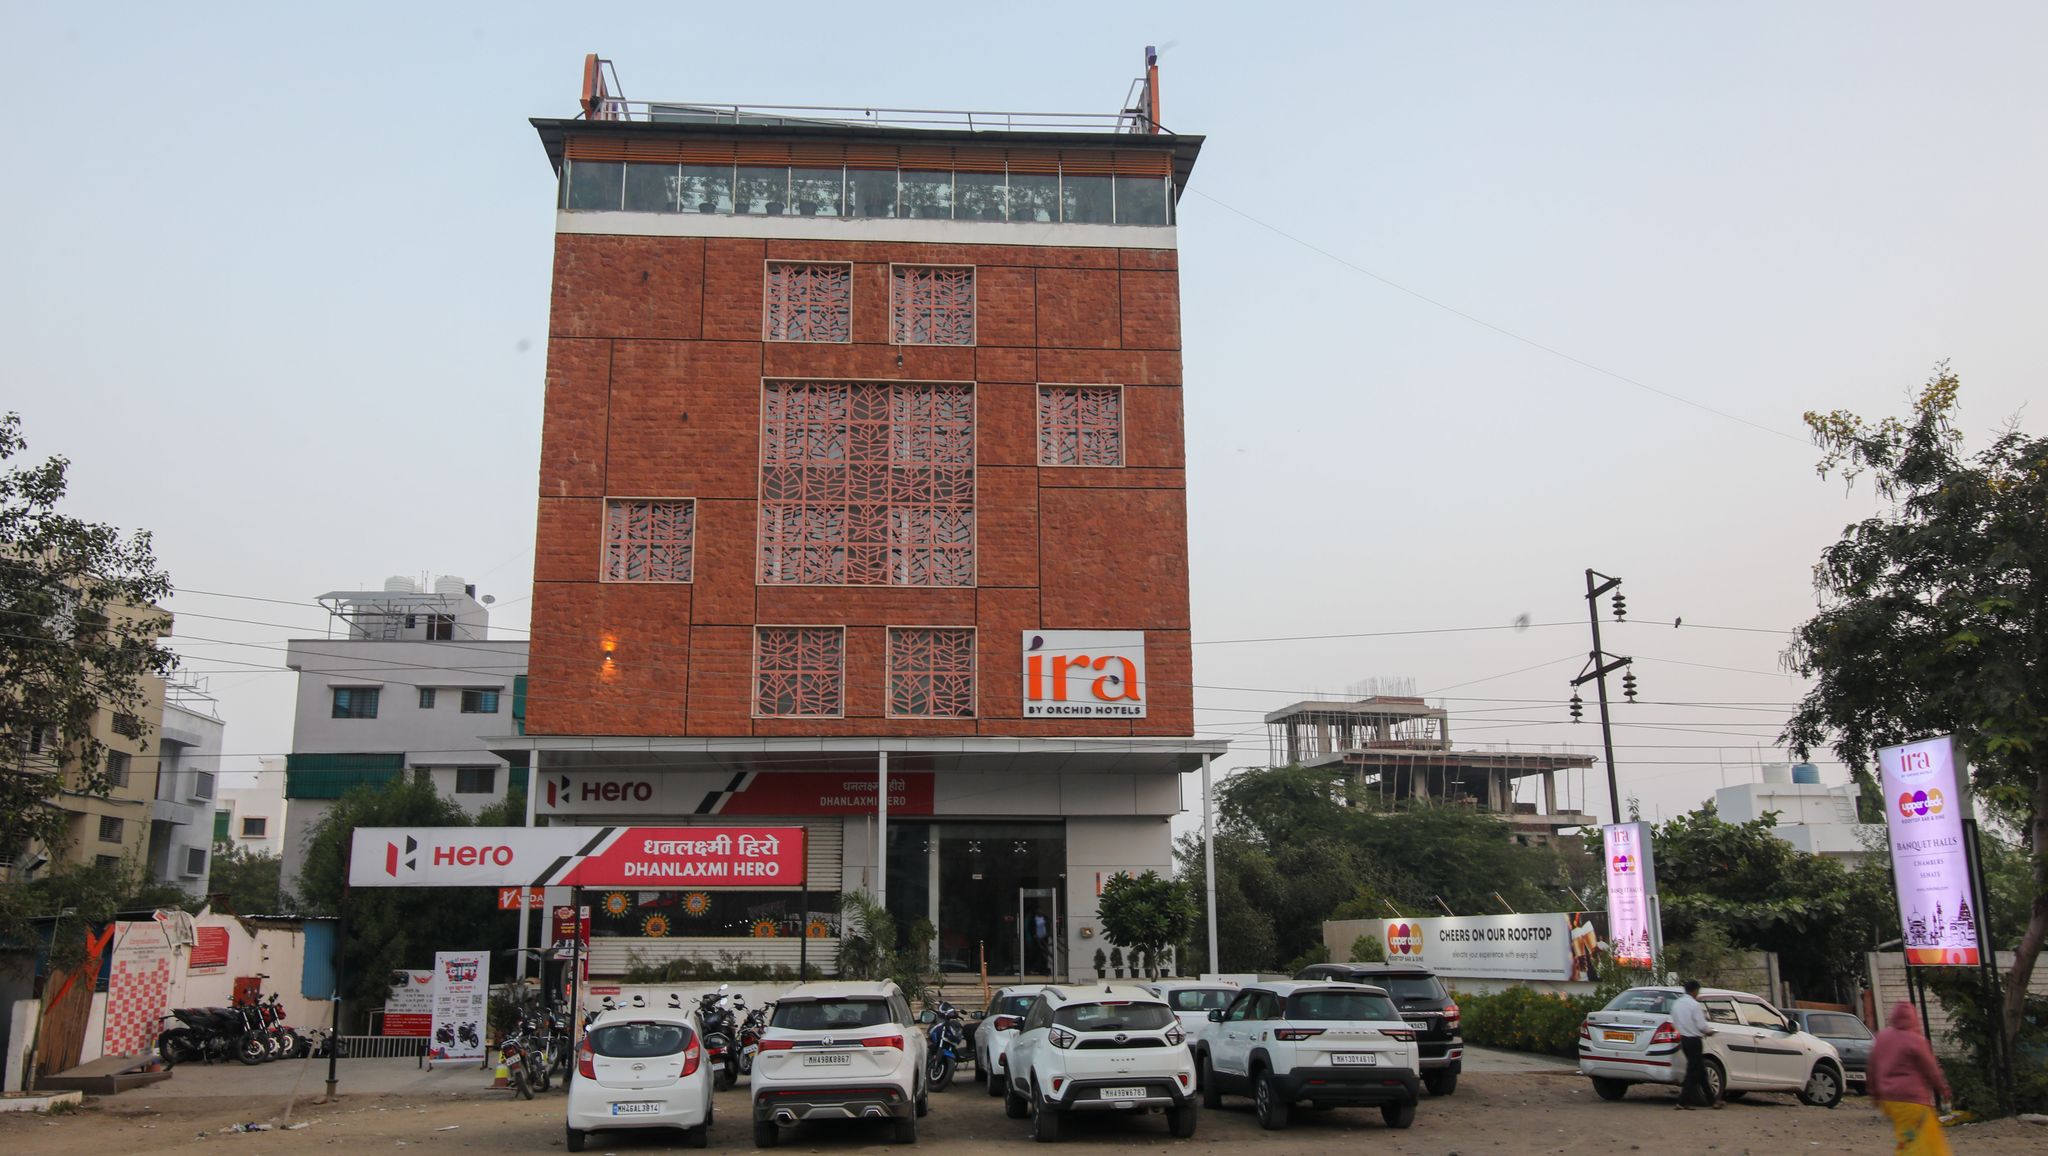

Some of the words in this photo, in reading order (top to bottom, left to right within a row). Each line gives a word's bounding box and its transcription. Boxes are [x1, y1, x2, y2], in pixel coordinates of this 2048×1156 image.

[1028, 635, 1141, 701] ira
[1028, 706, 1043, 715] BY
[1046, 706, 1092, 715] ORCHID
[1095, 706, 1141, 715] HOTELS
[1900, 748, 1930, 772] ira
[820, 796, 878, 806] DHANLAXMI
[887, 796, 906, 806] ERO
[643, 833, 733, 857] धनलक्ष्मी
[738, 833, 780, 858] हिरो
[1896, 839, 1932, 851] BANQUET
[1933, 837, 1958, 847] HALLS
[624, 861, 728, 877] DHANLAXMI
[733, 861, 780, 877] HERO
[1439, 929, 1471, 942] CHEERS
[1472, 928, 1485, 941] ON
[1487, 928, 1506, 941] OUR
[1507, 927, 1553, 941] ROOFTOP
